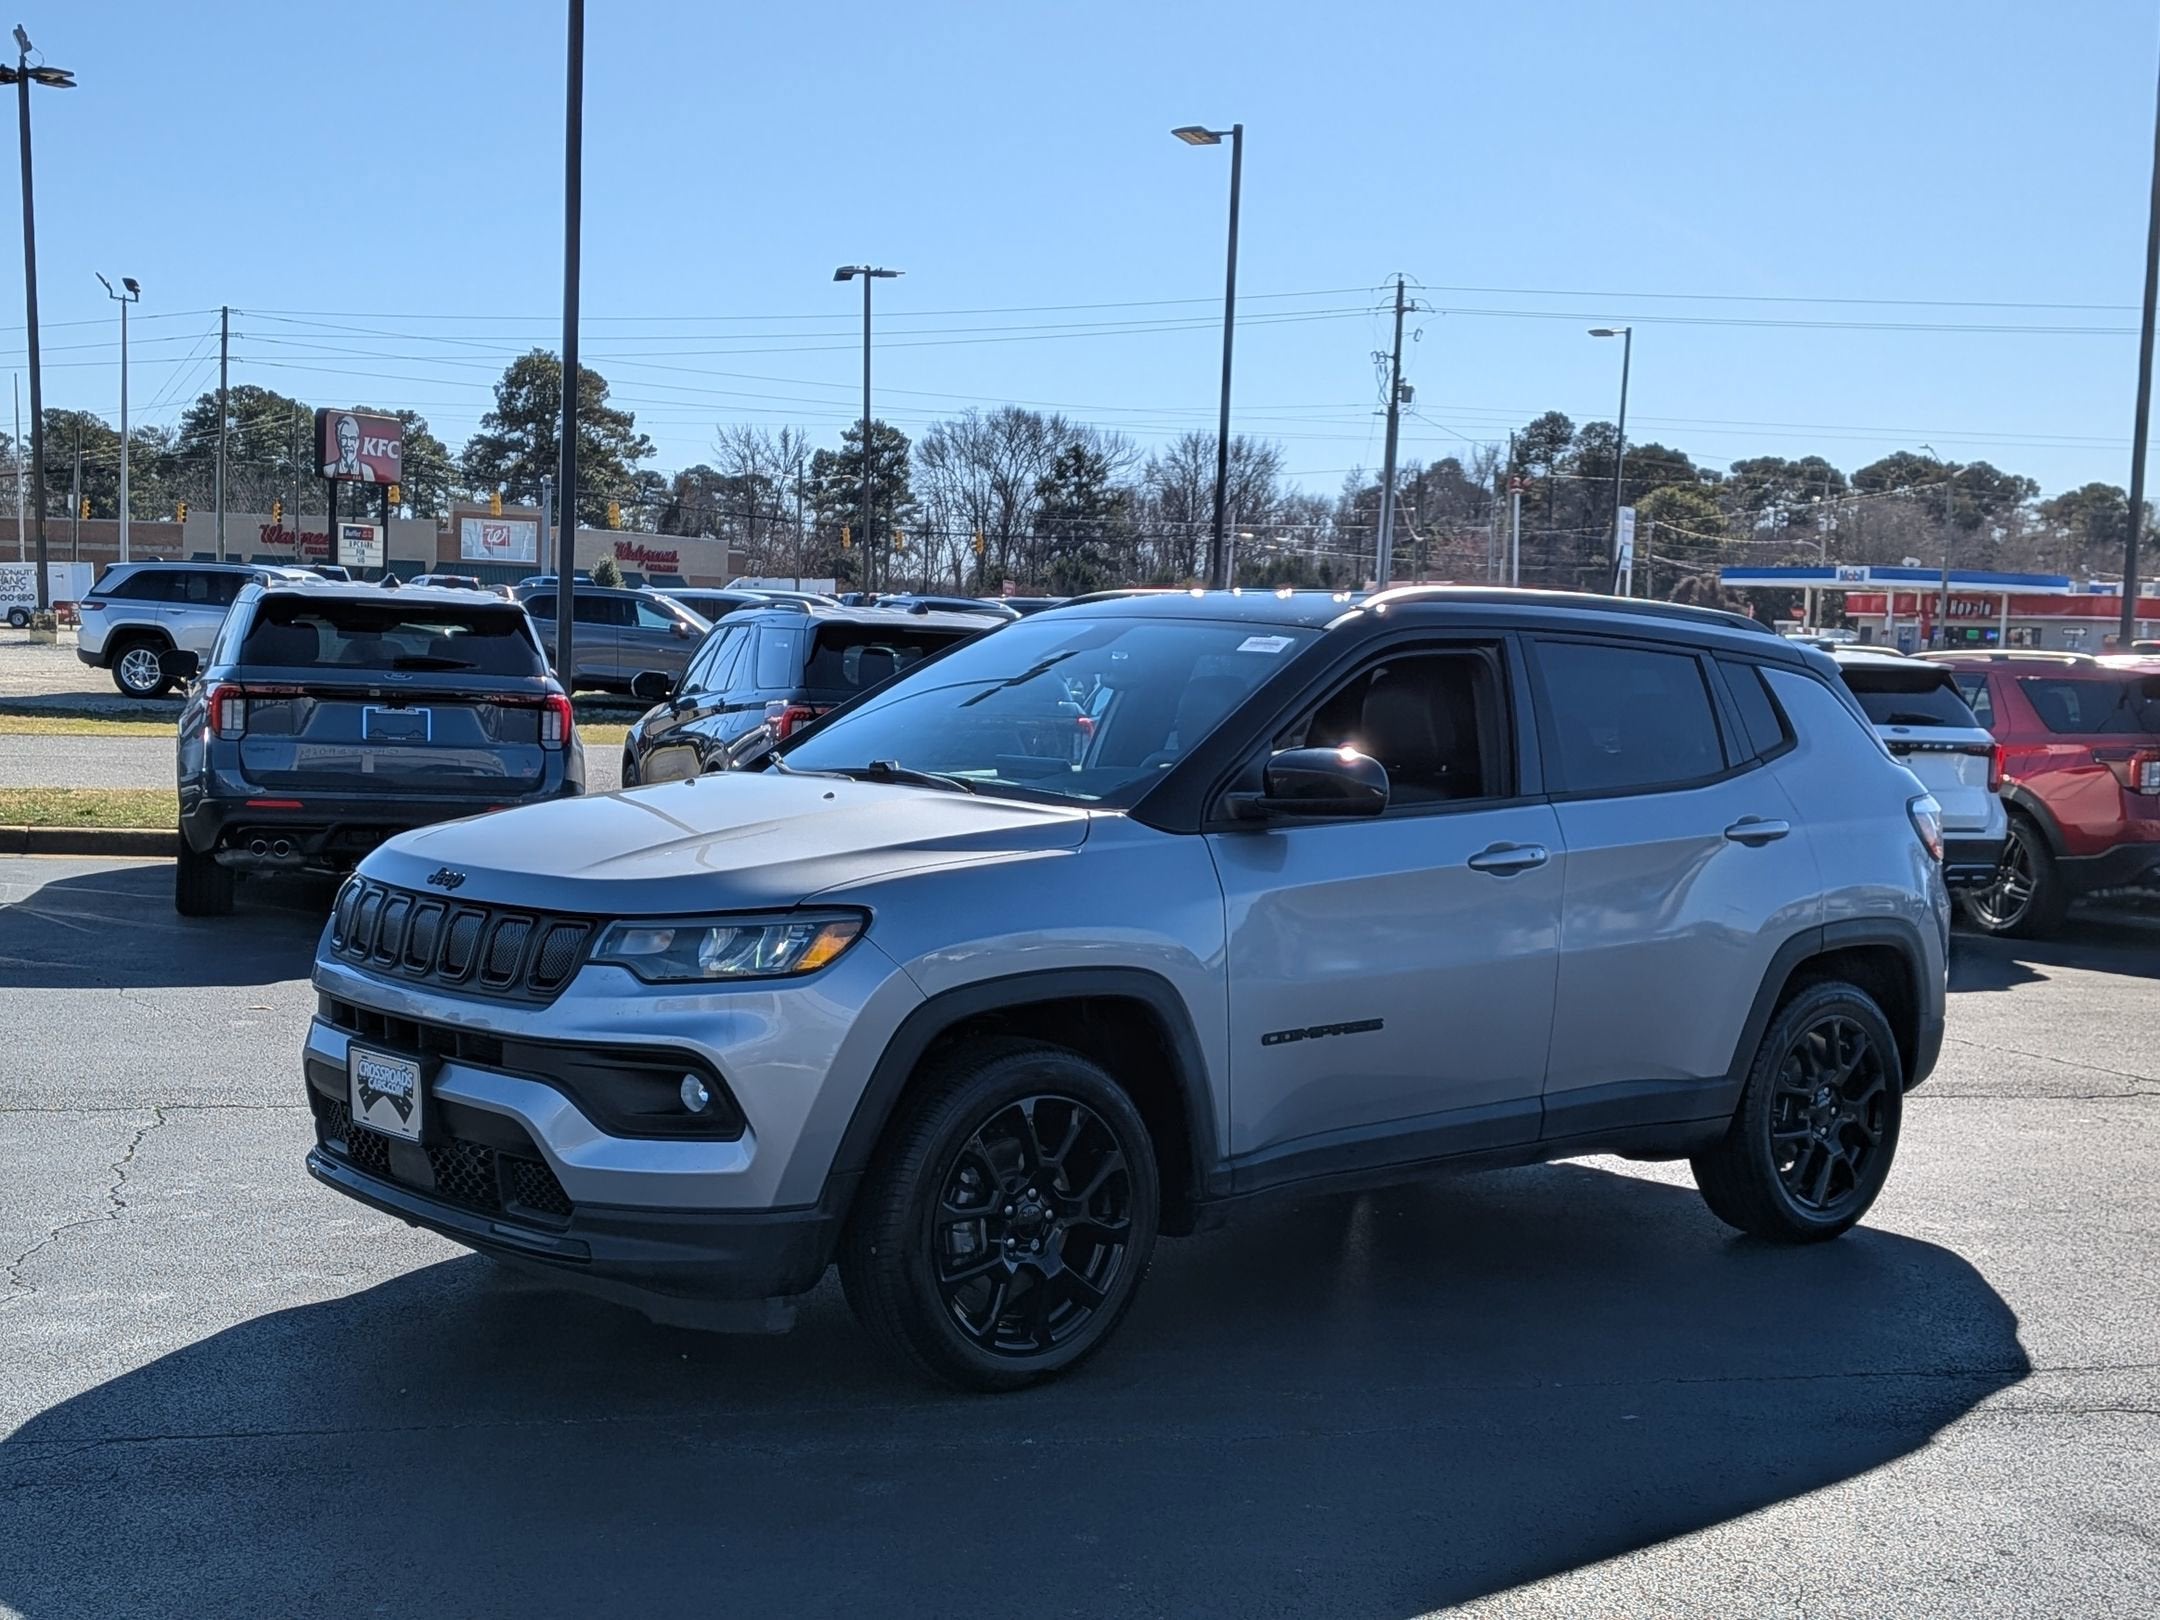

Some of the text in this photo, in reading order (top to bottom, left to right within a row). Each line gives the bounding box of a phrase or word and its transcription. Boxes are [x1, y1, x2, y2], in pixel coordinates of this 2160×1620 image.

[362, 436, 400, 459] KFC
[259, 523, 329, 551] Walgree
[614, 541, 679, 568] Walgreens
[1840, 570, 1865, 582] Mobil
[426, 867, 467, 892] Jeep
[1261, 1018, 1384, 1046] COMPASS
[358, 1060, 414, 1089] CROSSROADS
